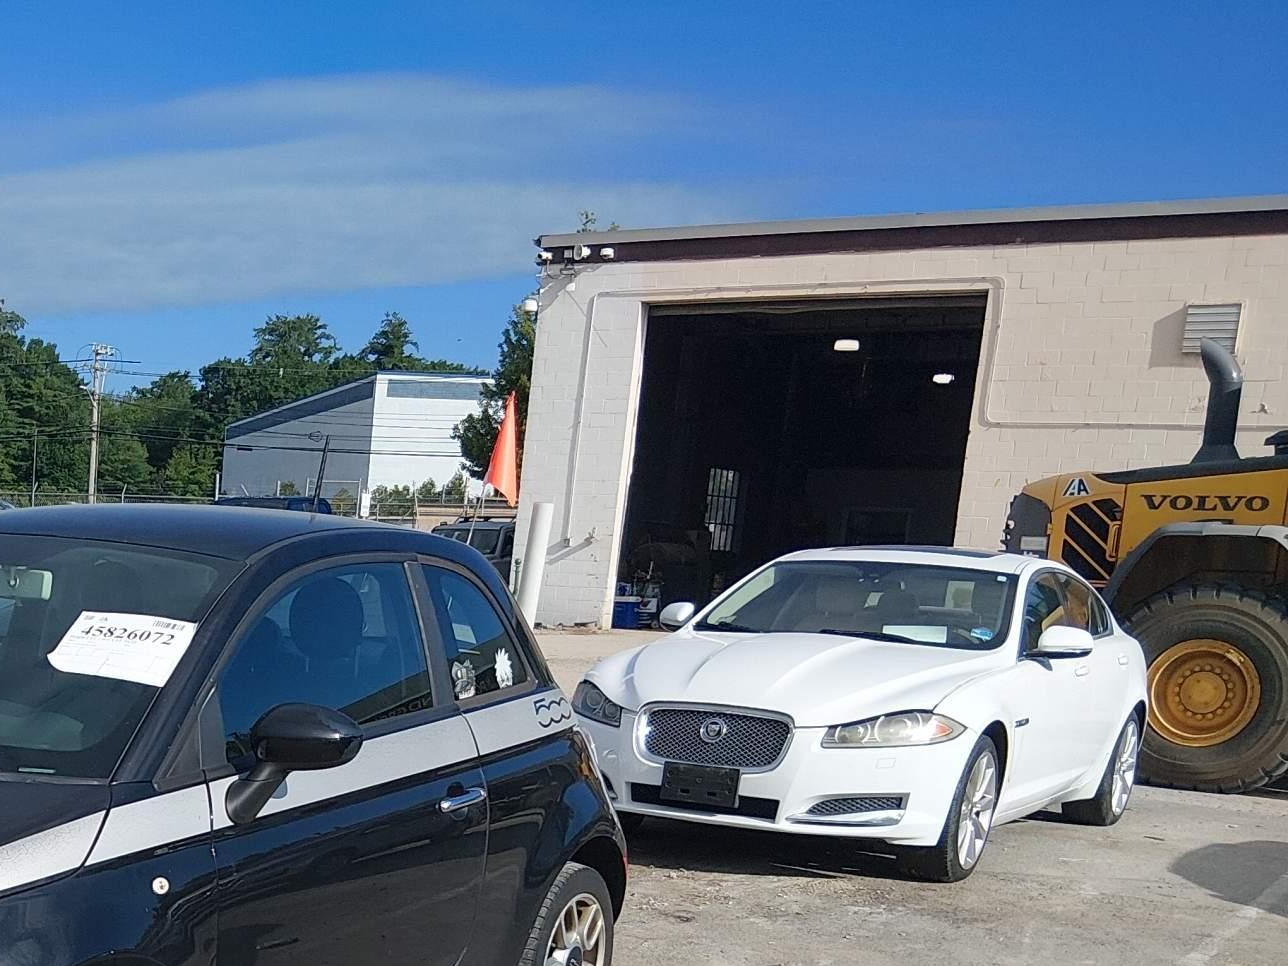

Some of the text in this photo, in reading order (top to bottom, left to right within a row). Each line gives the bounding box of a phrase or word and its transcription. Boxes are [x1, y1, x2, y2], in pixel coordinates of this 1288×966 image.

[1140, 494, 1270, 512] VOLVO
[81, 625, 175, 646] 45826072
[533, 696, 572, 728] 500
